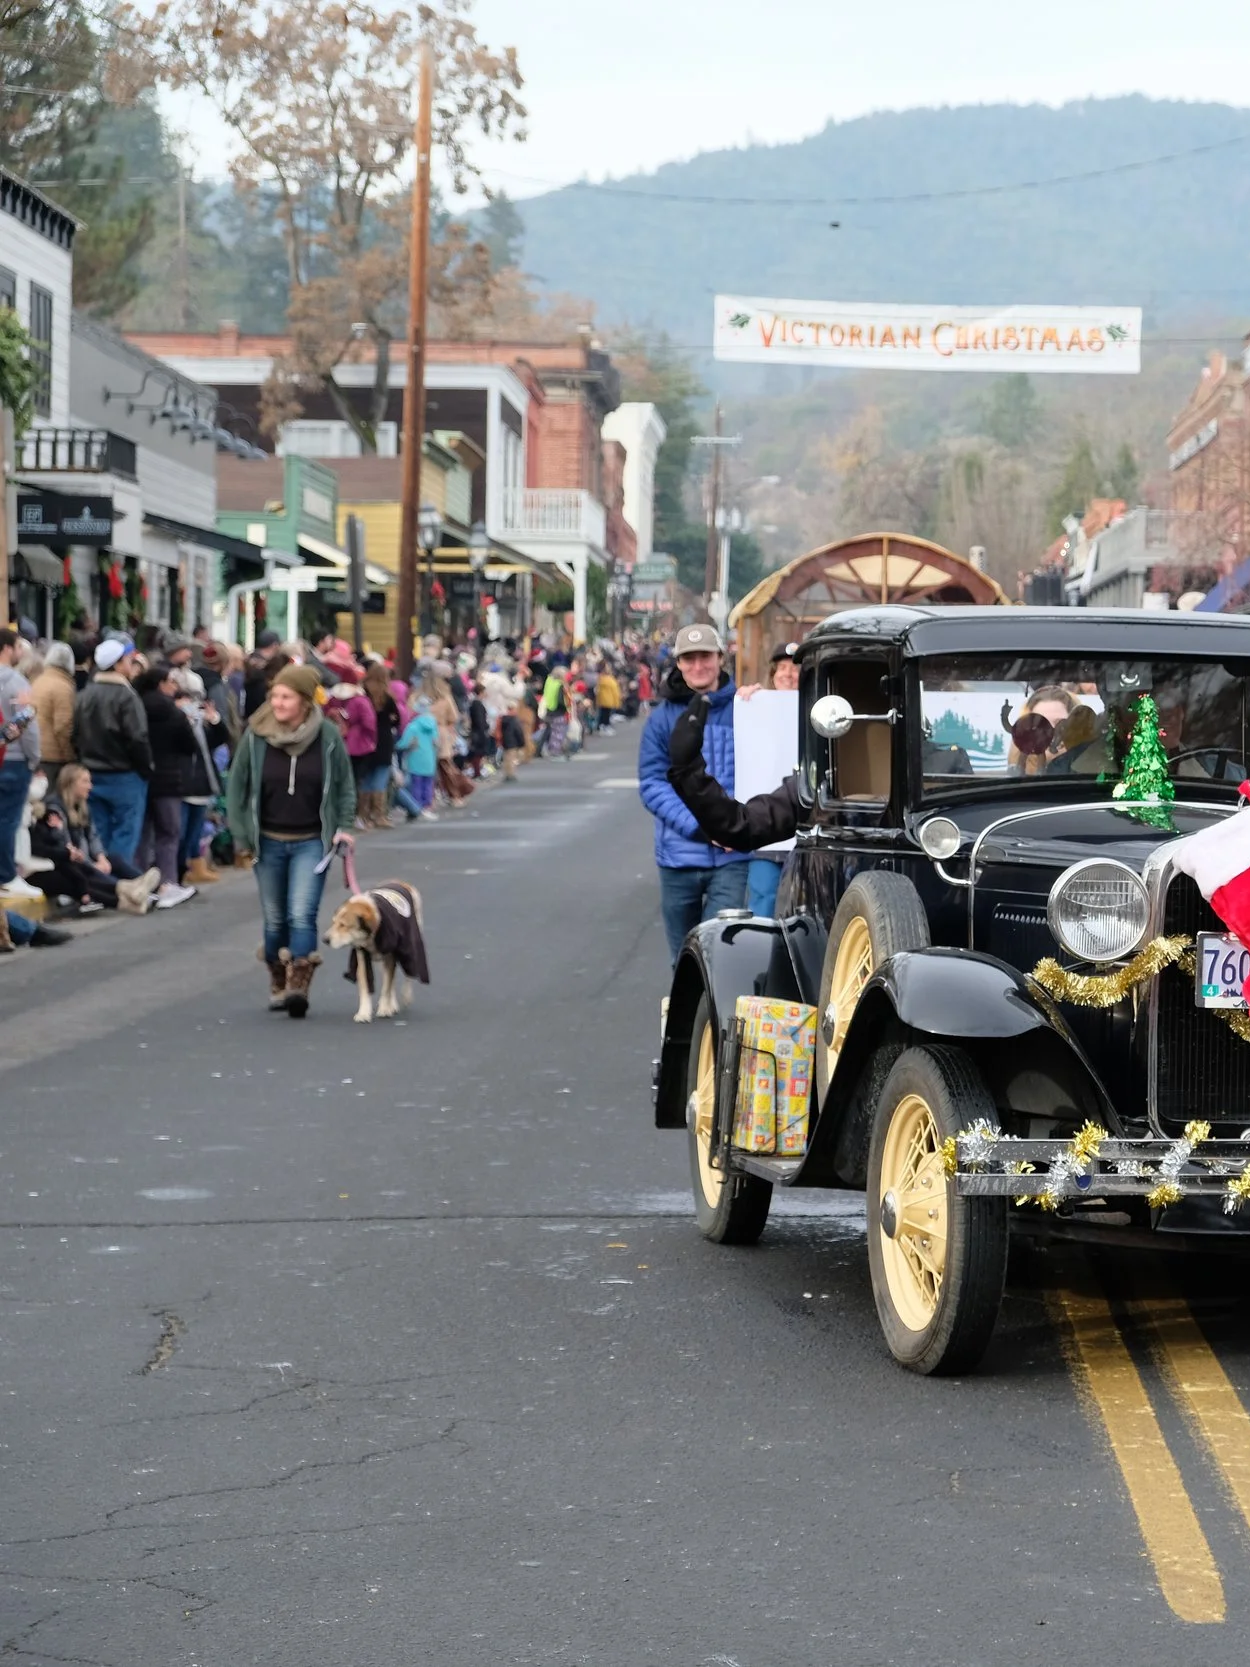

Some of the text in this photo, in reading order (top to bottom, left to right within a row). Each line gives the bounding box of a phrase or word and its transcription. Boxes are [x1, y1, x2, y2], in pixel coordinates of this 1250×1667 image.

[758, 315, 1106, 356] VICTORIAN CHRISTMAS
[1206, 986, 1214, 996] 4
